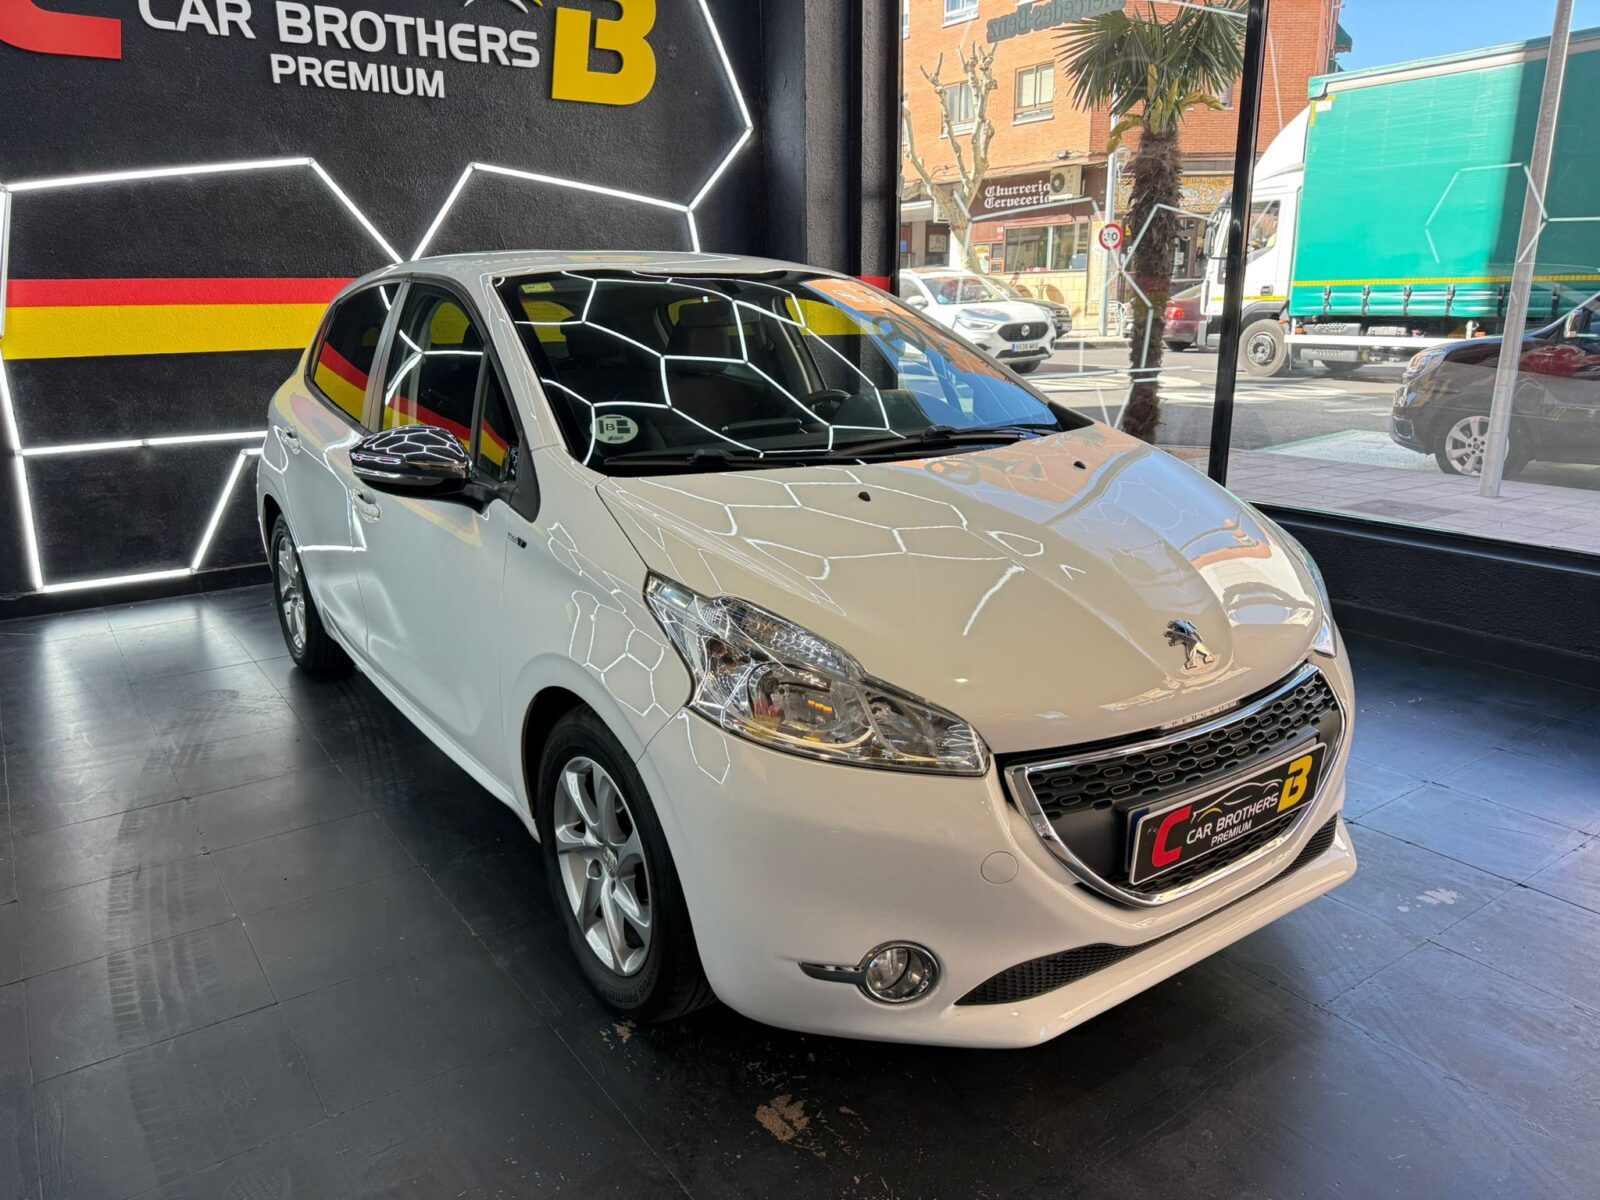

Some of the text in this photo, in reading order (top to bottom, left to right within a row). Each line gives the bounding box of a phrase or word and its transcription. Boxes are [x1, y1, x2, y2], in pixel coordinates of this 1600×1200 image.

[138, 0, 256, 39] CAR
[277, 1, 541, 69] BROTHERS
[271, 53, 445, 99] PREMIUM
[1103, 231, 1118, 242] 30
[1277, 755, 1313, 813] B
[1152, 805, 1193, 868] C
[1186, 790, 1279, 845] CAR BROTHERS
[1210, 822, 1252, 847] PREMIUM
